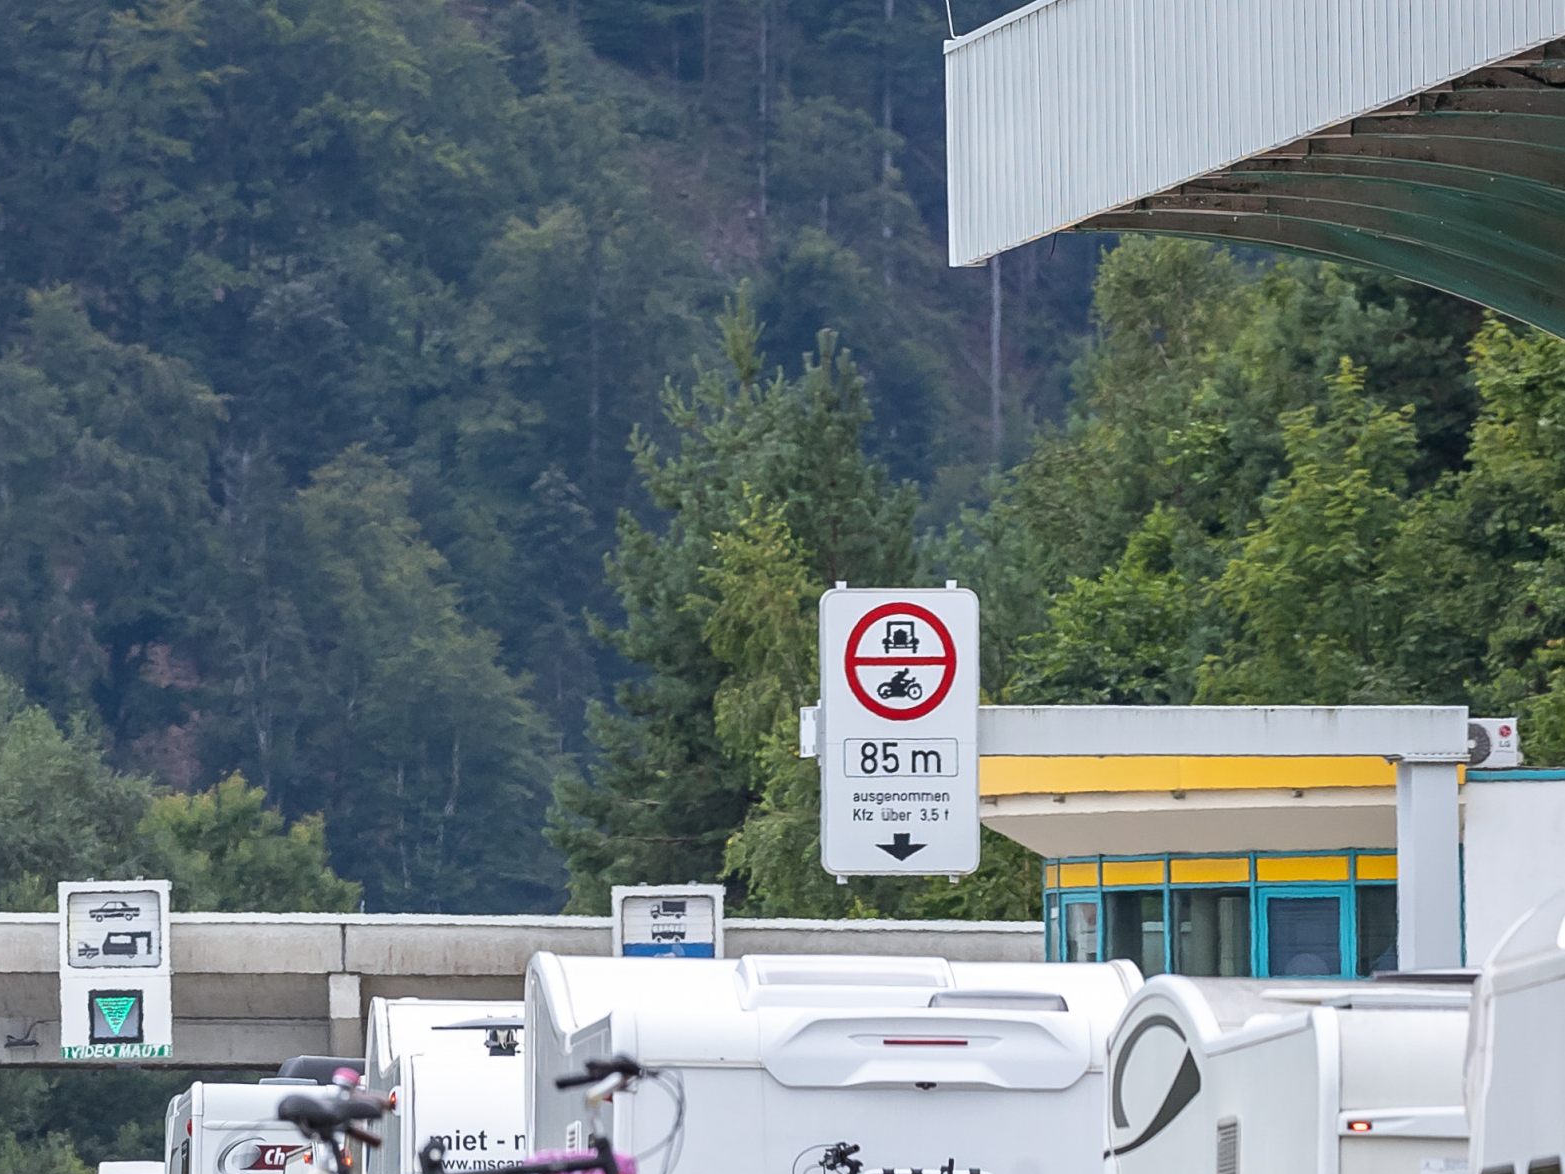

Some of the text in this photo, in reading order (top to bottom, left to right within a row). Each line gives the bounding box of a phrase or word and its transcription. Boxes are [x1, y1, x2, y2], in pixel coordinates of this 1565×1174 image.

[860, 741, 942, 774] 85 m
[852, 792, 951, 805] ausgenommen
[852, 808, 874, 822] Kfz
[881, 807, 912, 822] über
[920, 808, 939, 823] 3,5
[430, 1129, 488, 1151] miet
